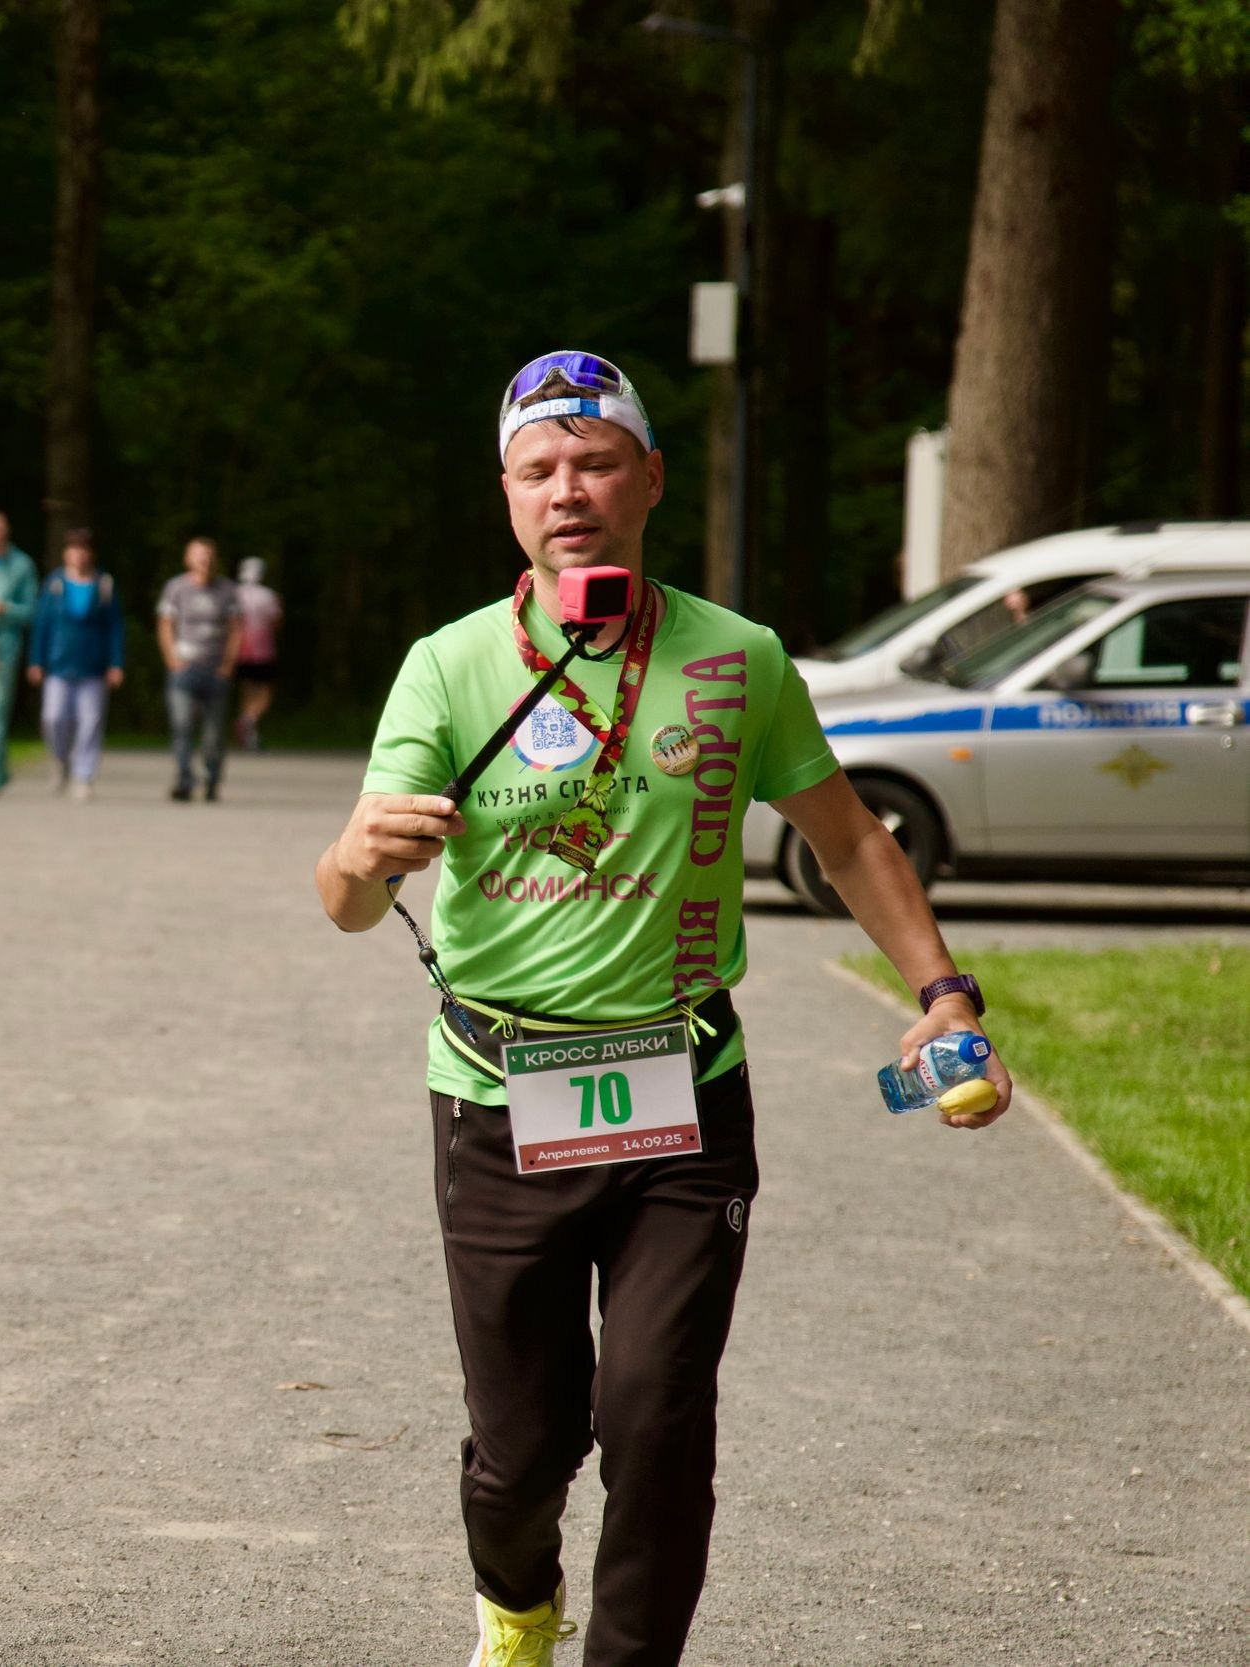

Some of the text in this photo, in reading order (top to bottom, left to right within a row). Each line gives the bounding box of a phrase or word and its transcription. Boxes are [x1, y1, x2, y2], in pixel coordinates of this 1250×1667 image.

[477, 776, 650, 808] КУЗНЯ СПРТА
[496, 812, 555, 826] ВСЕГДА В
[672, 649, 747, 1001] ЗНЯ СПОРТА
[524, 1035, 669, 1067] КРОСС ДУБКИ
[569, 1071, 633, 1129] 70
[538, 1133, 683, 1161] Апрелевка 14.09.25
